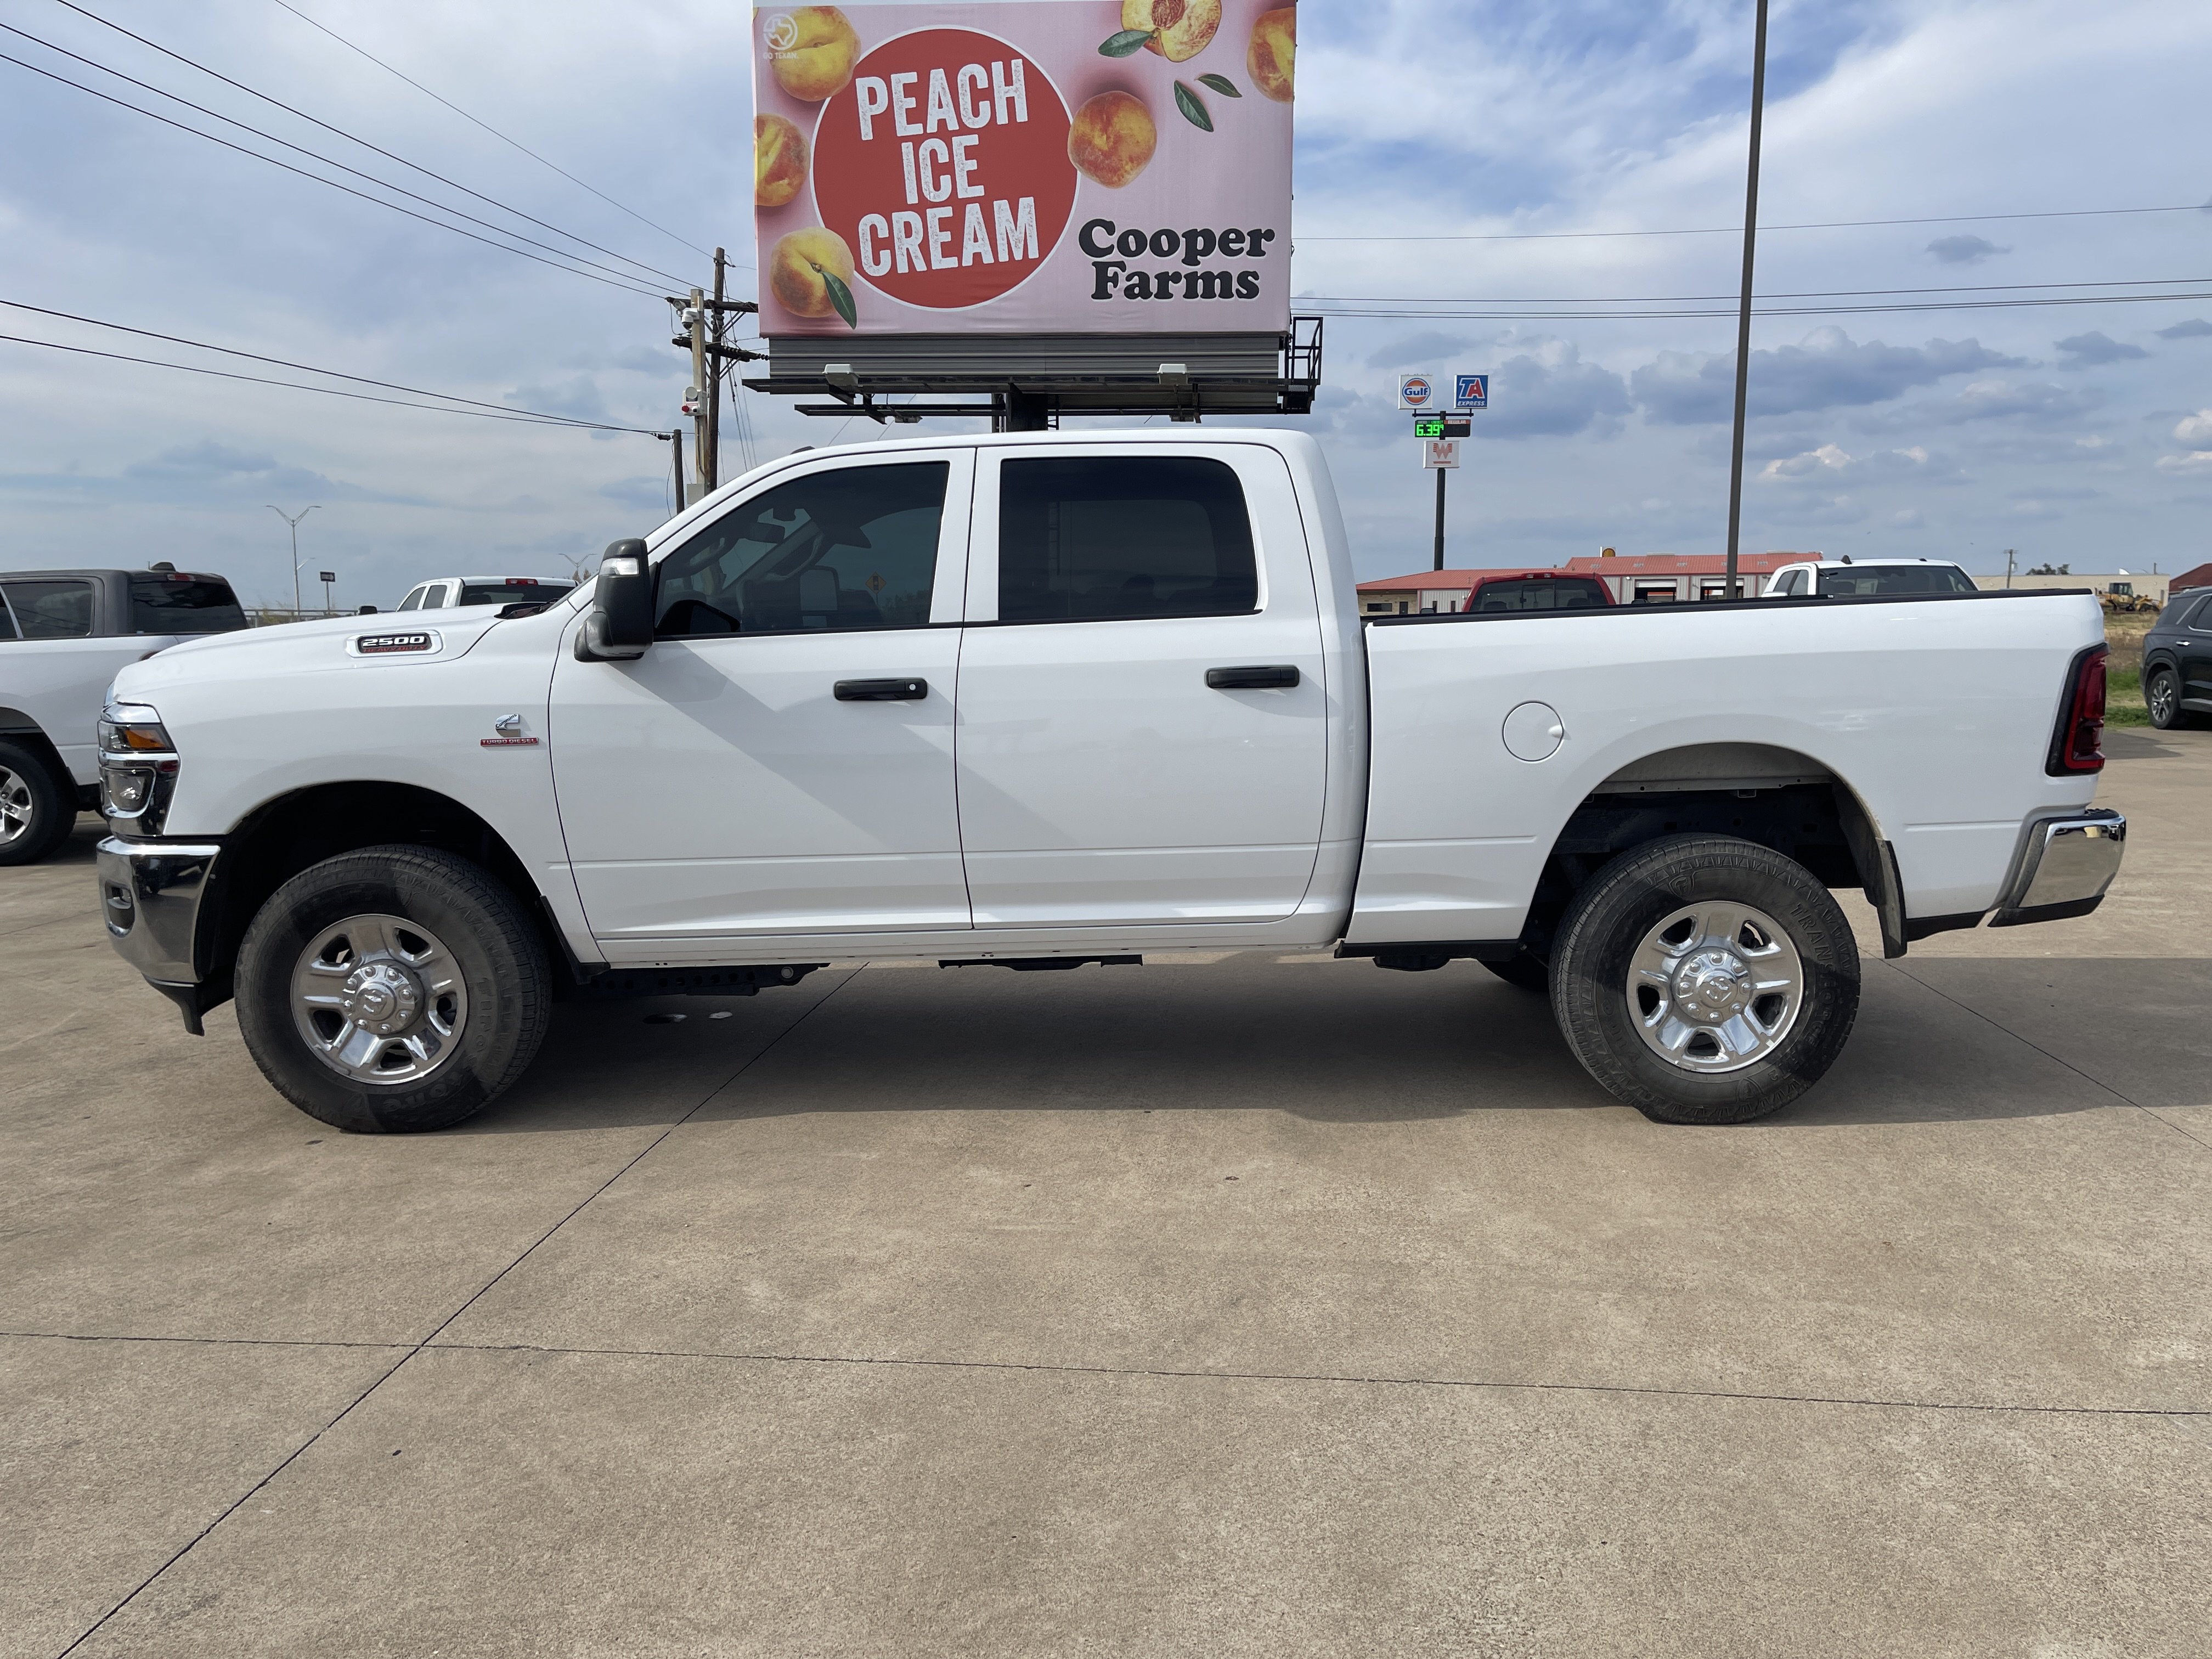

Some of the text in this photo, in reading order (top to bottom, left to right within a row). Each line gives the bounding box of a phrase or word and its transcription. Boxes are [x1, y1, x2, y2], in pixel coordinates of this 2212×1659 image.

[855, 59, 1028, 140] PEACH
[901, 134, 985, 204] ICE
[858, 196, 1039, 276] CREAM
[1079, 218, 1275, 266] Cooper
[1091, 261, 1260, 300] Farms
[1404, 387, 1428, 396] Gulf
[1459, 378, 1485, 399] TA
[363, 636, 425, 646] 2500
[495, 714, 517, 728] Cummins
